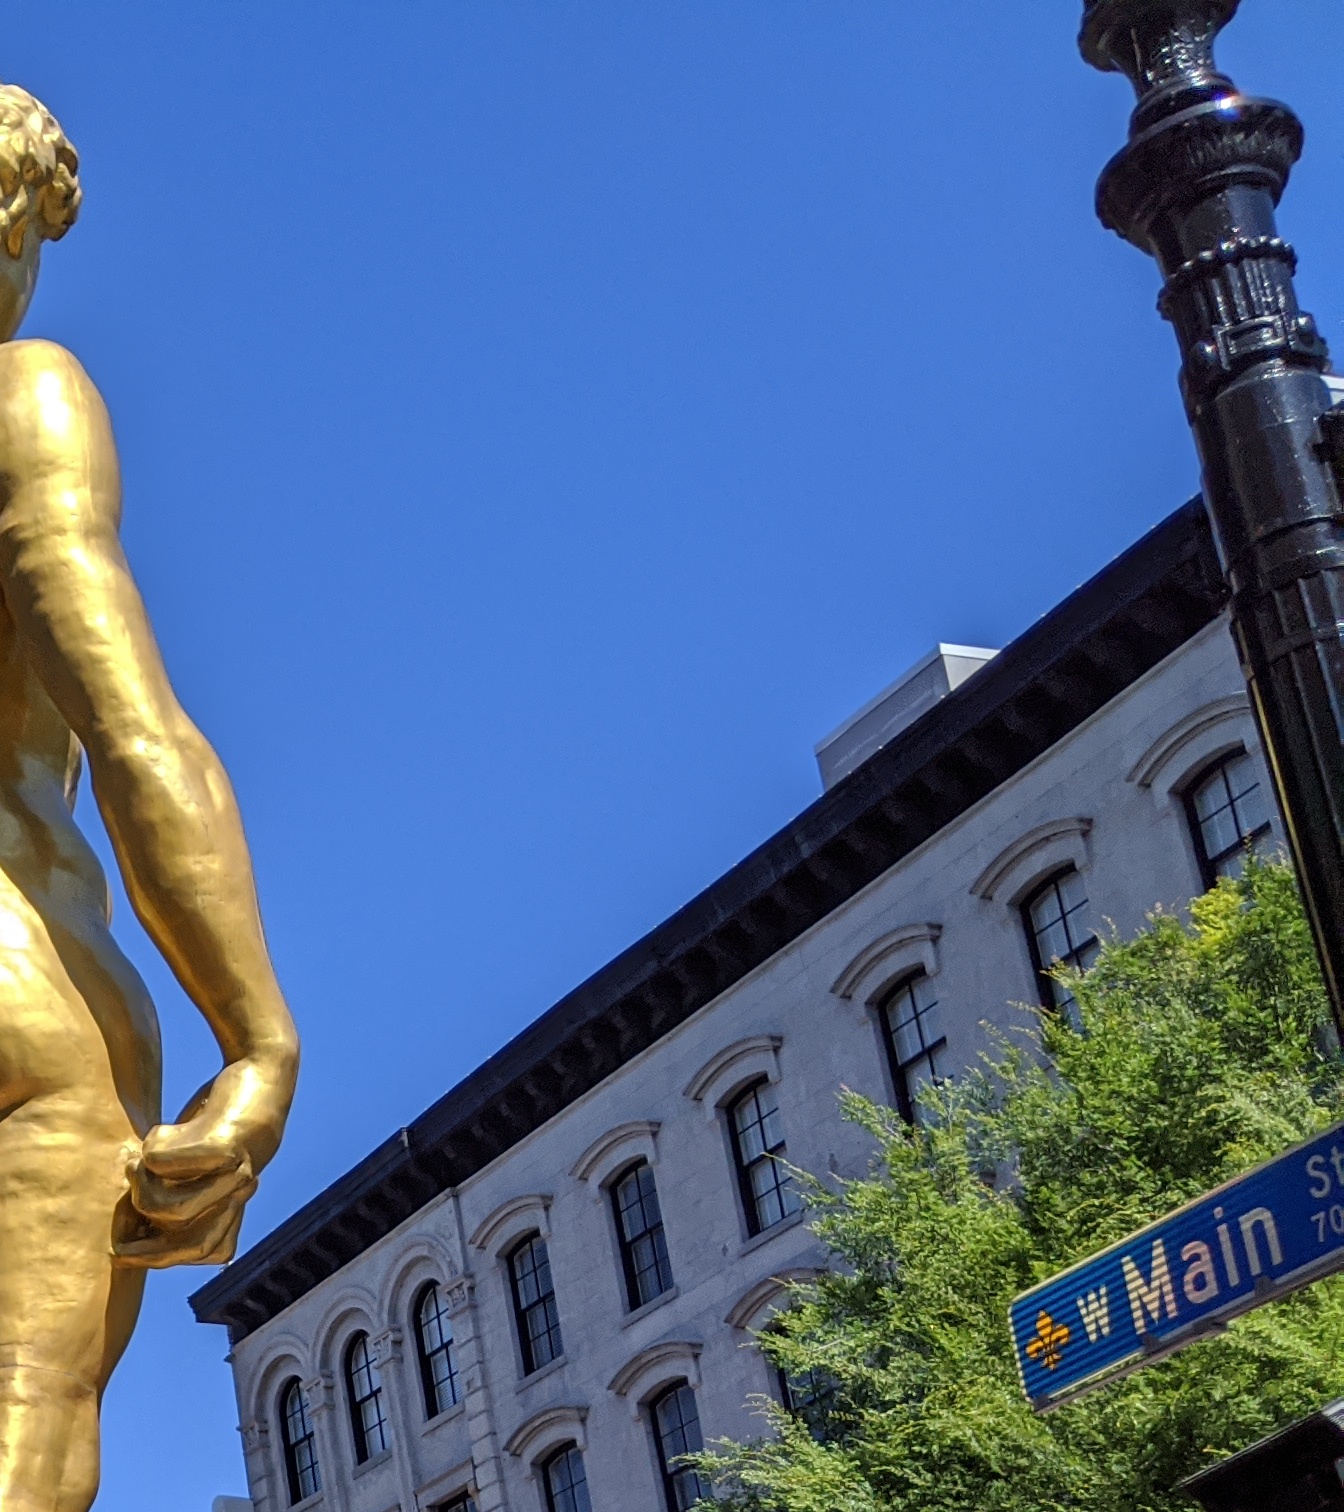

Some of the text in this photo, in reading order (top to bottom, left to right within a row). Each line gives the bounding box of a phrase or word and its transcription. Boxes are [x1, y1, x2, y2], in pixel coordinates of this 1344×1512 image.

[1075, 1145, 1344, 1344] W Main St
